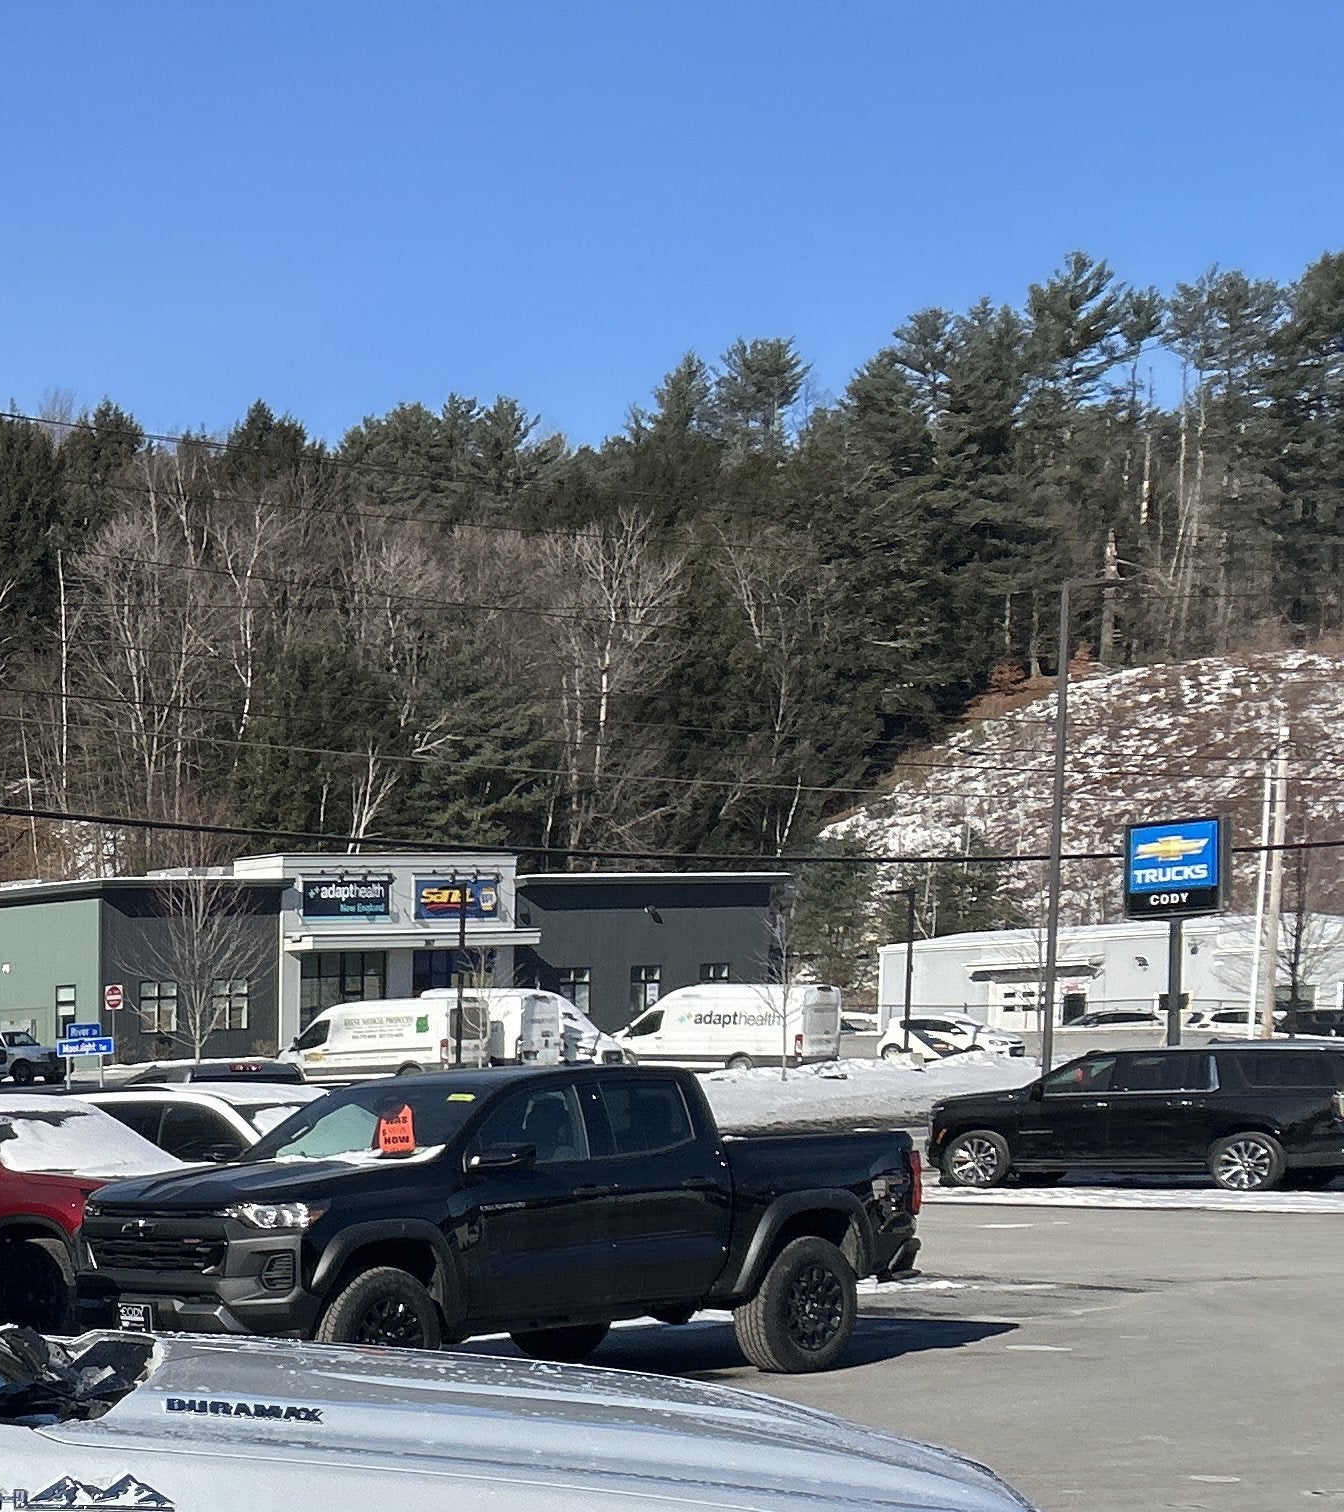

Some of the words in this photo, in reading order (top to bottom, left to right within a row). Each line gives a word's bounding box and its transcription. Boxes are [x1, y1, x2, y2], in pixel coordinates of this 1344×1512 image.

[1133, 863, 1209, 884] TRUCKS
[320, 882, 385, 901] adapthealth
[1149, 892, 1190, 906] CODY
[693, 1010, 783, 1028] adapthealth
[166, 1398, 324, 1424] DURAMAX
